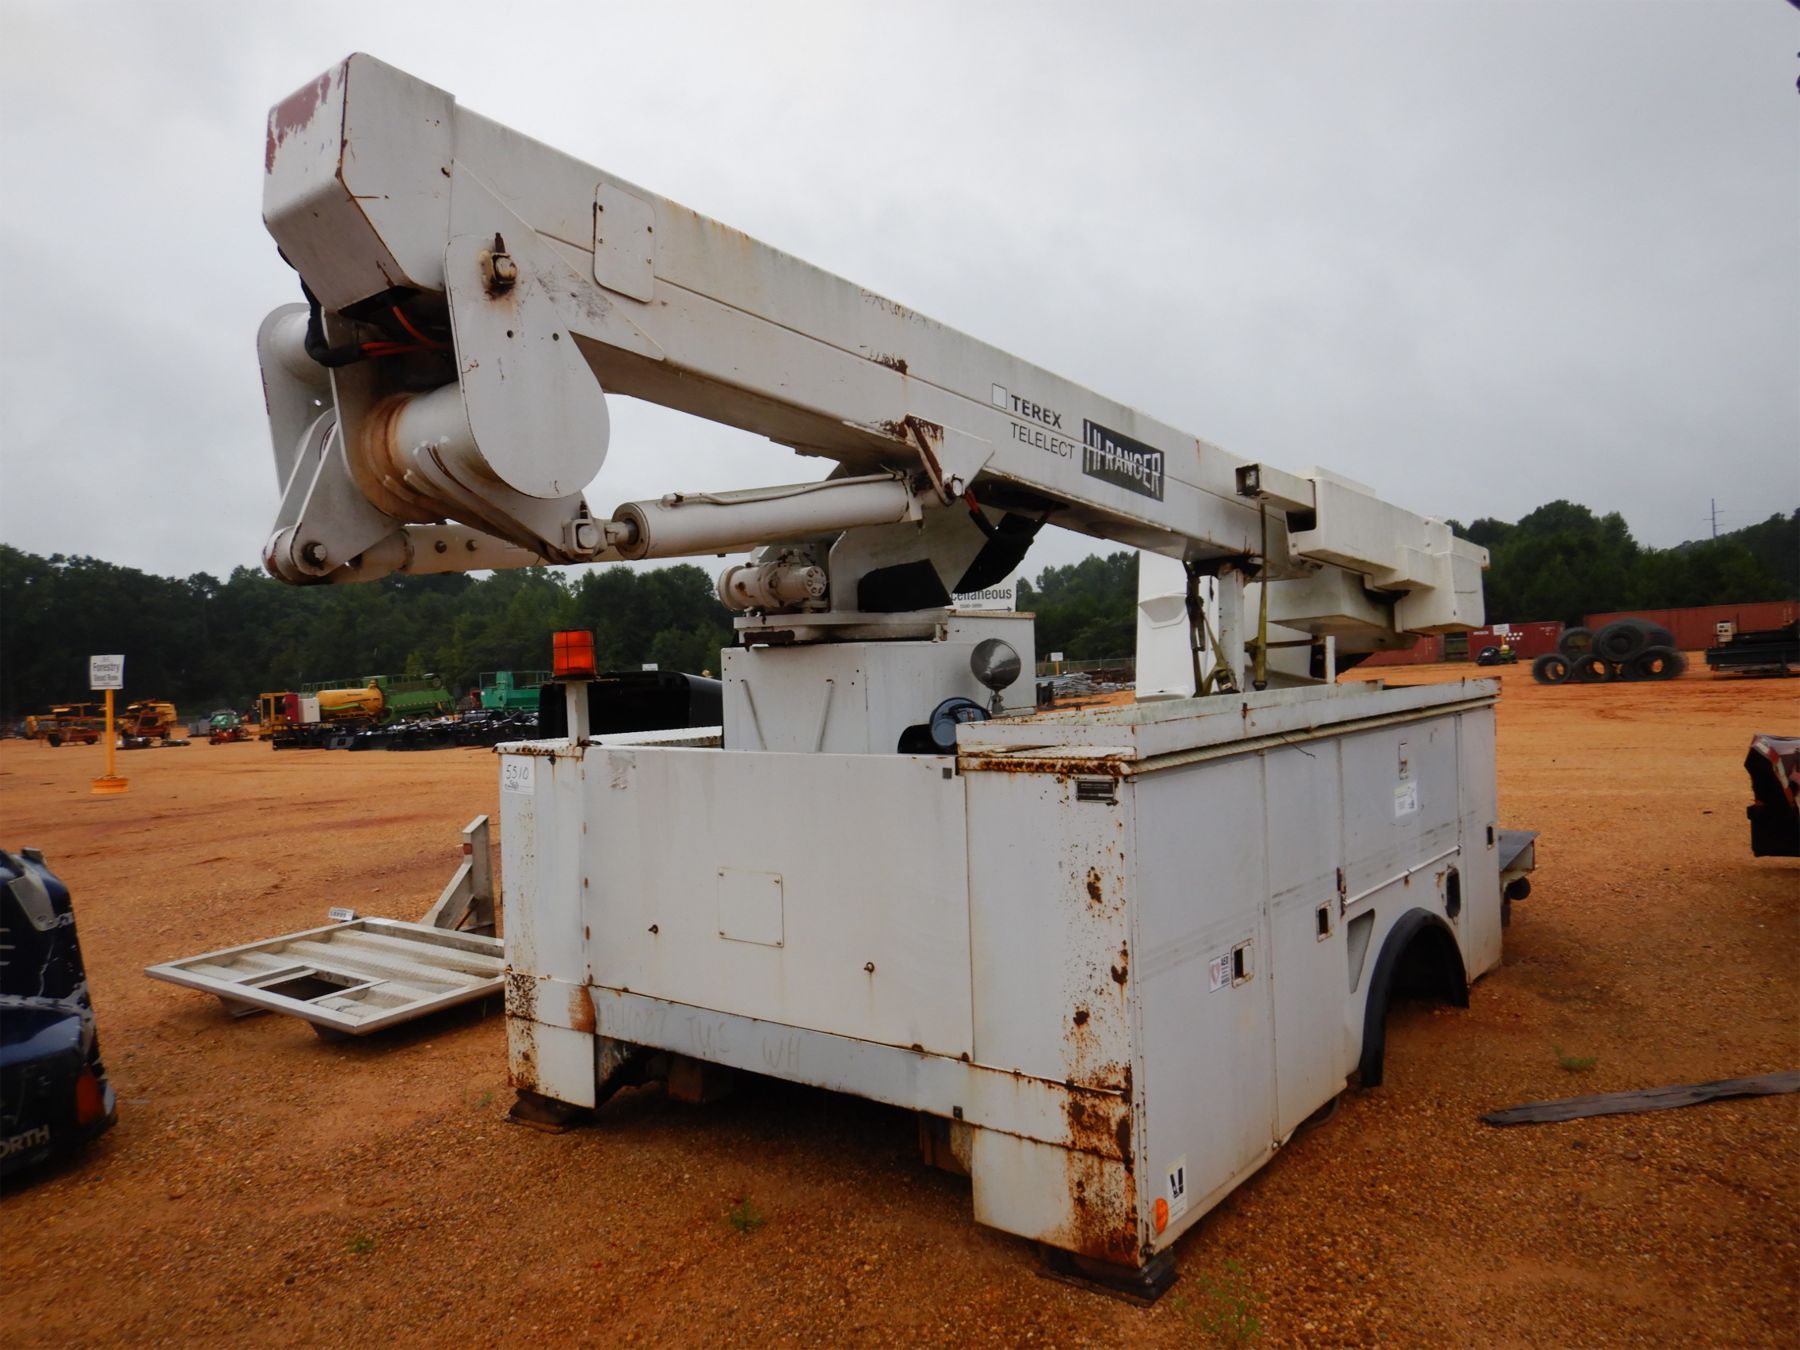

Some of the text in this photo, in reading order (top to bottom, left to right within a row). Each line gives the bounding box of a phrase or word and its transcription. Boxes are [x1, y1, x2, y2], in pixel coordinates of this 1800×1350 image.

[1010, 394, 1062, 429] TEREX
[1010, 422, 1075, 460] TELELECT
[951, 588, 1012, 601] cellaneous
